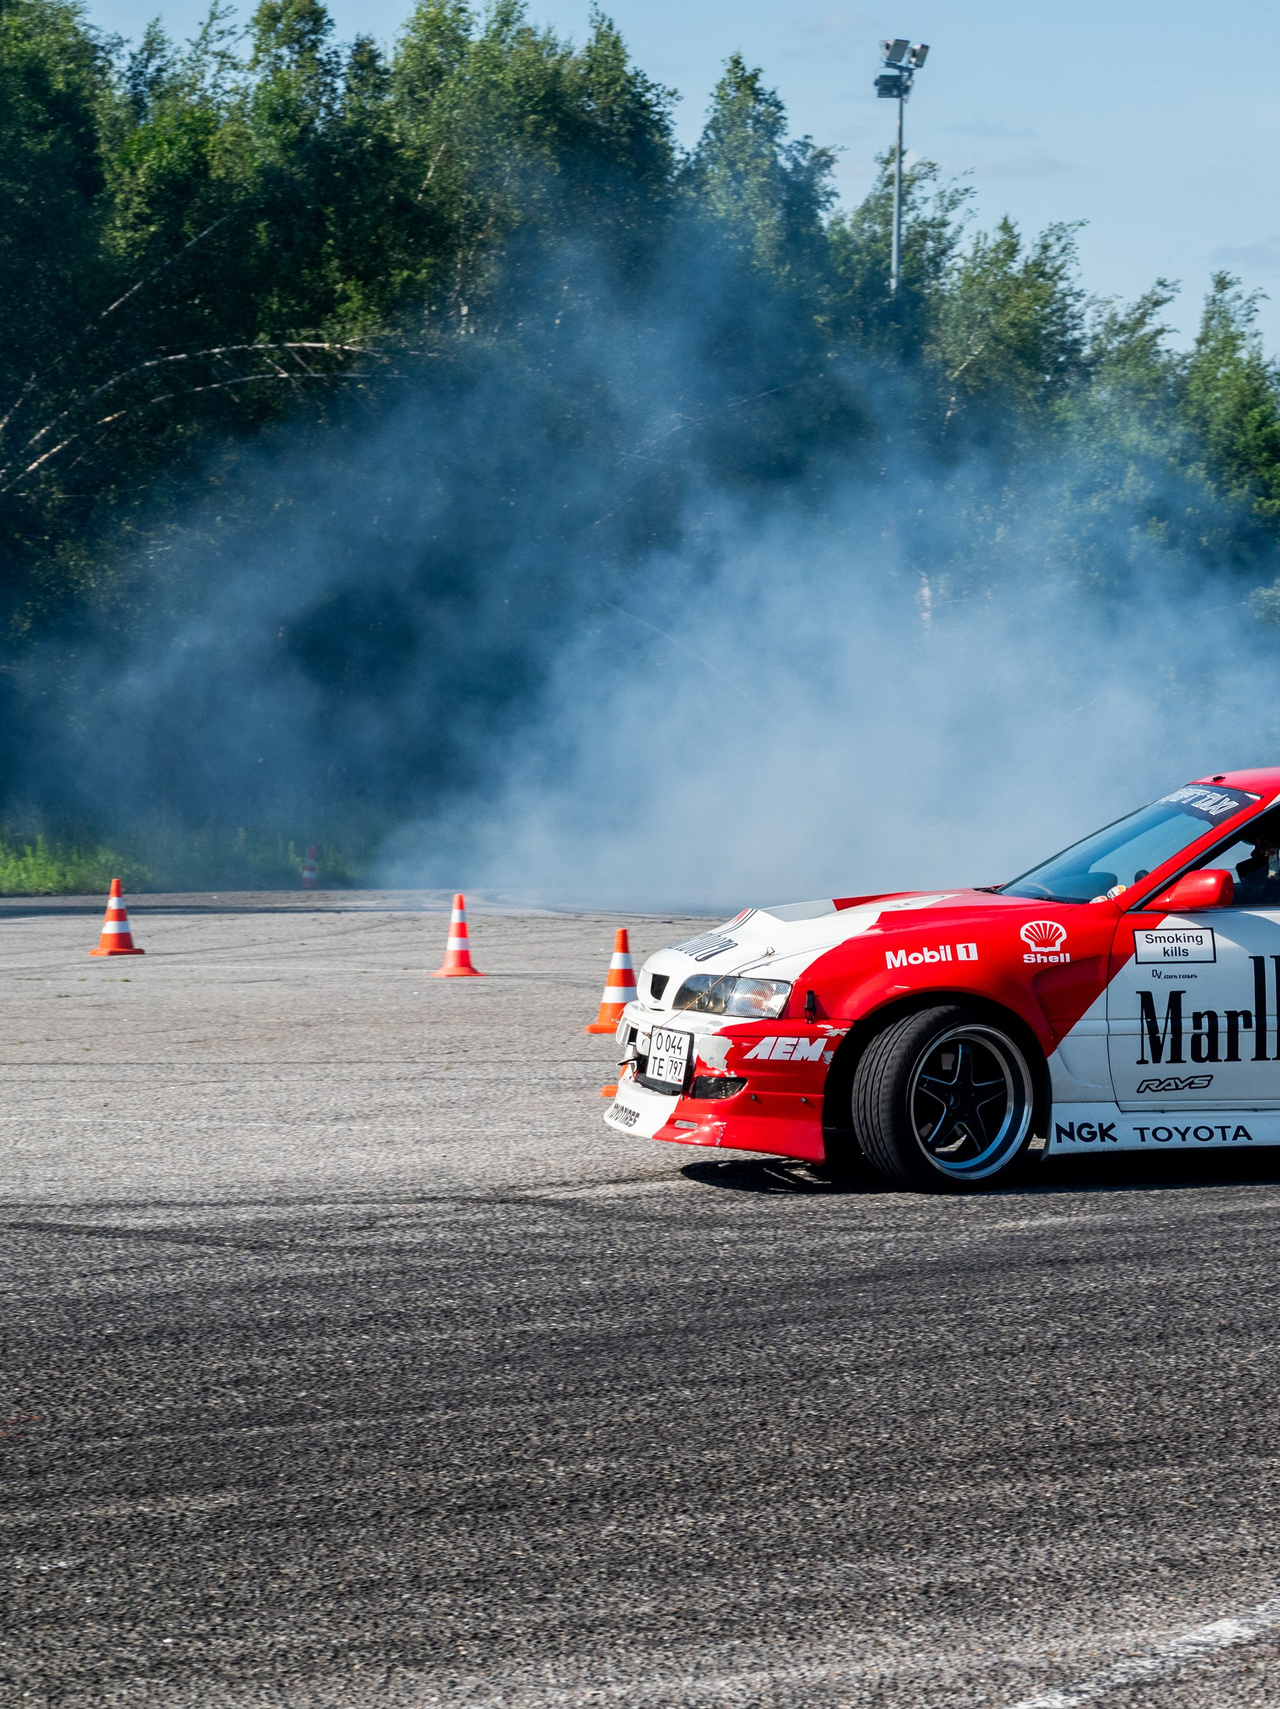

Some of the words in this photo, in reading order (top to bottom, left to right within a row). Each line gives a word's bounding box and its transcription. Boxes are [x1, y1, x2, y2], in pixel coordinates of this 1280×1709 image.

[1145, 933, 1203, 945] Smoking
[885, 944, 952, 969] Mobil
[1023, 953, 1071, 963] Shell
[1163, 946, 1189, 957] kills
[665, 1034, 683, 1055] 044
[743, 1036, 828, 1061] AEM
[651, 1056, 665, 1076] TE
[669, 1059, 683, 1076] 797
[1136, 1075, 1213, 1093] RAYS
[1055, 1121, 1118, 1143] NGK
[1133, 1125, 1253, 1142] TOYOTA
